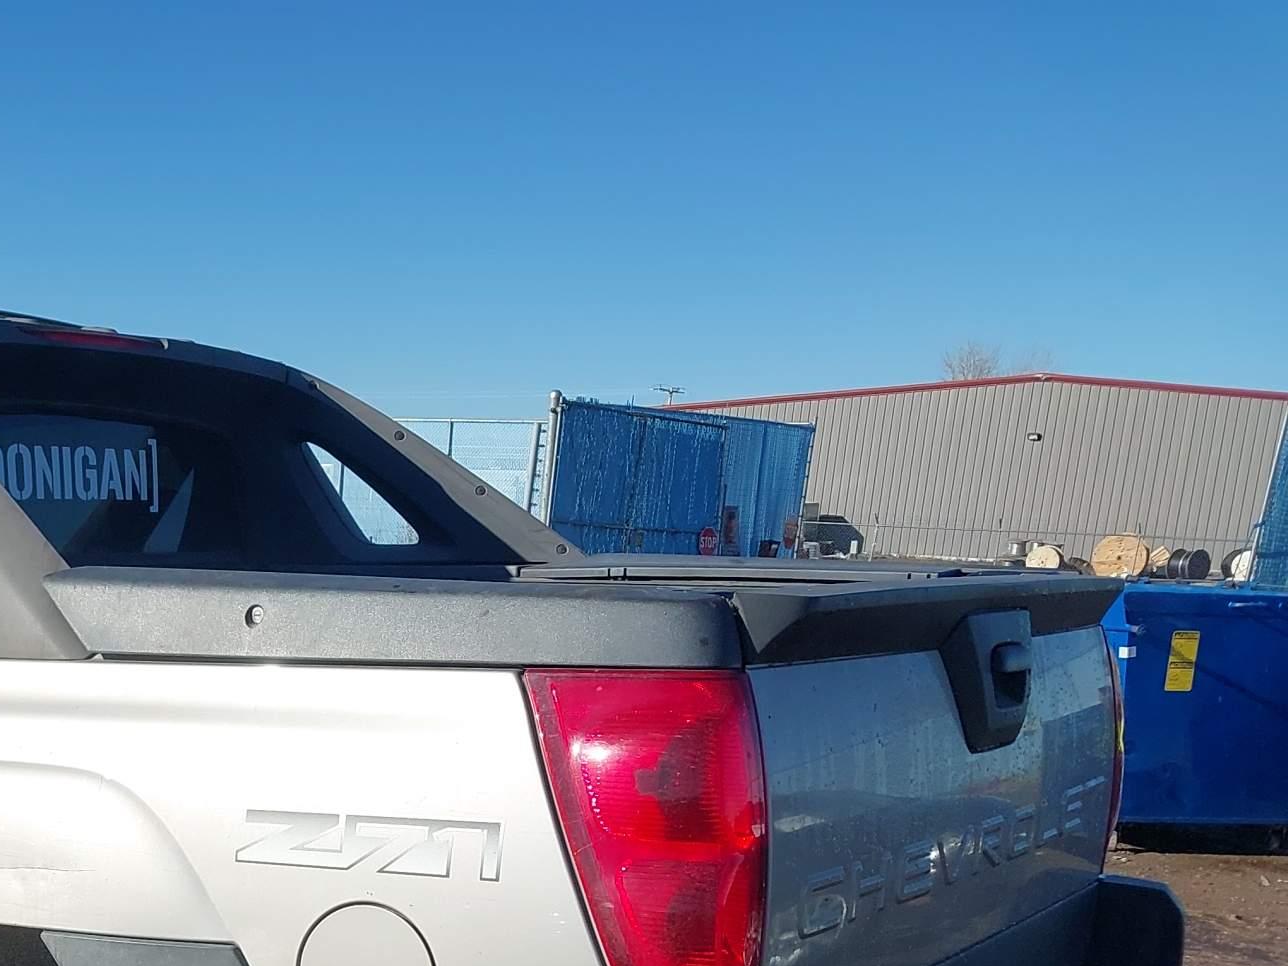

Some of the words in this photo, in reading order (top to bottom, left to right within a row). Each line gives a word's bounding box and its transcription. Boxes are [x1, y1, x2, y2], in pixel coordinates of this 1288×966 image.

[700, 536, 717, 549] STOP
[235, 809, 501, 882] Z71
[797, 774, 1106, 940] CHEVROLET
